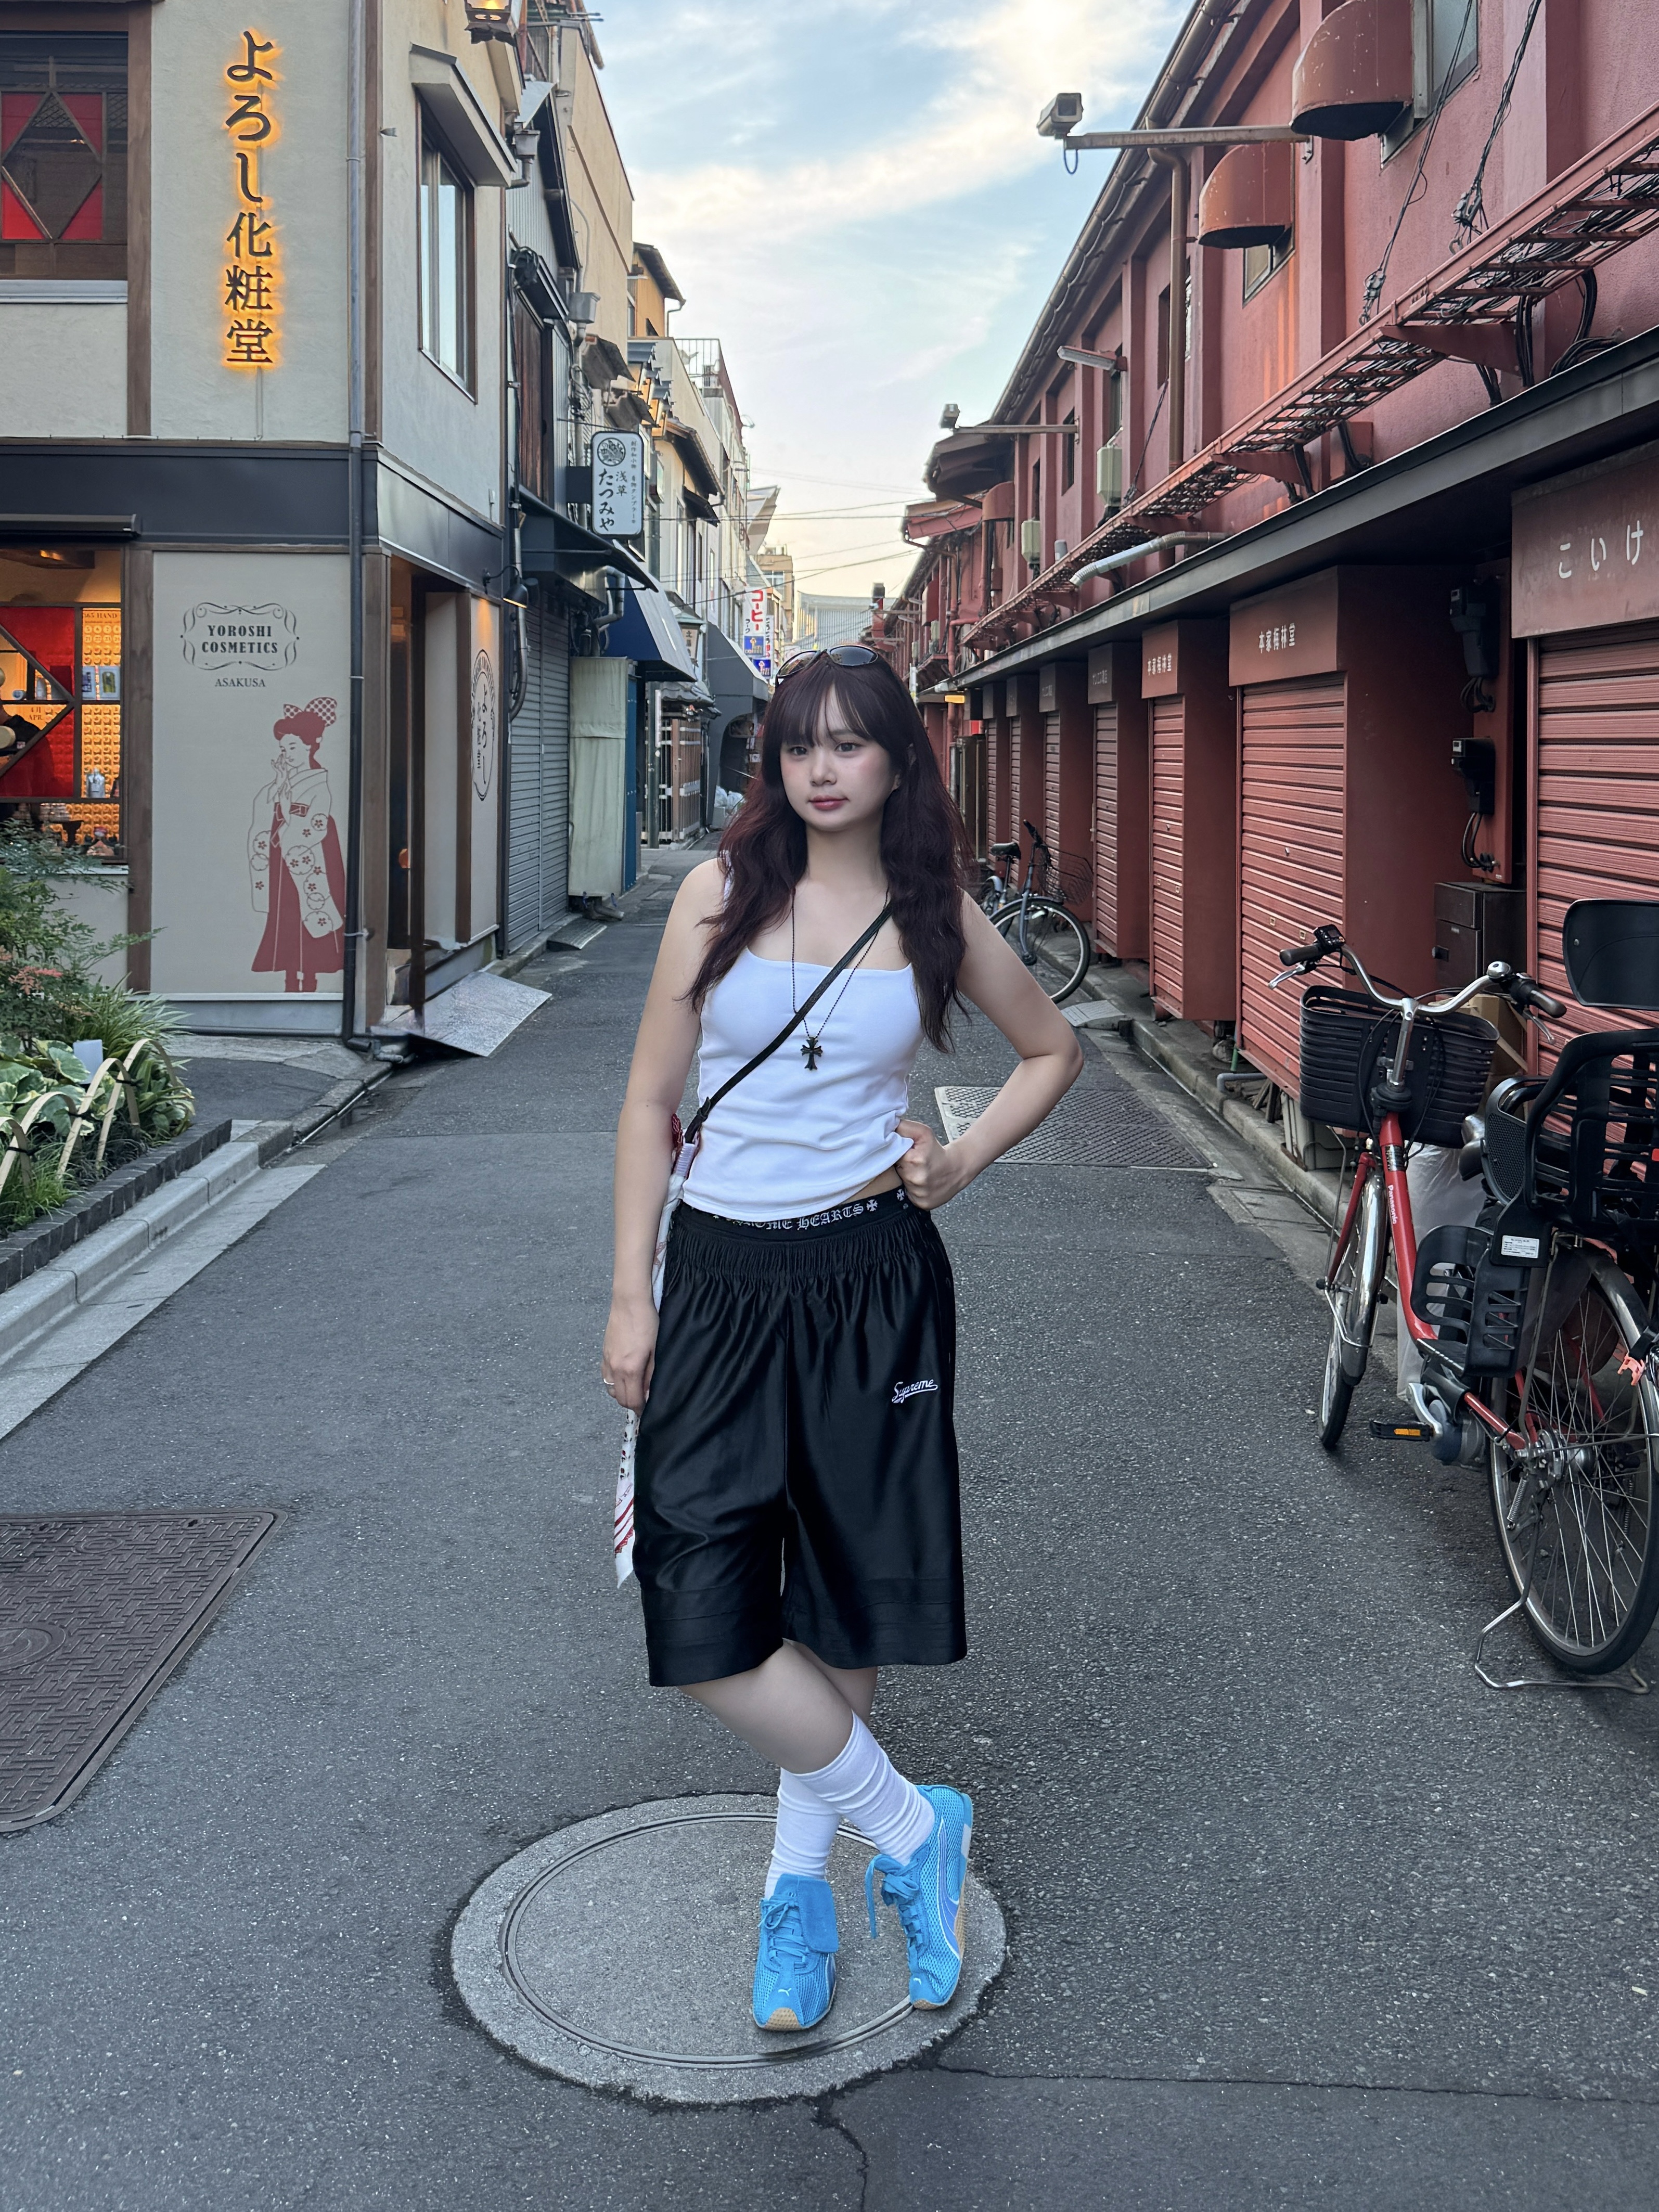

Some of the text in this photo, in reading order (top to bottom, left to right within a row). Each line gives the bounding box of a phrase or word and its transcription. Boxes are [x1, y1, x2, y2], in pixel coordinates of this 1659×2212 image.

[225, 31, 274, 364] よろし化粧堂
[615, 470, 627, 496] 浅草
[599, 468, 615, 531] たつみや
[1559, 520, 1643, 579] こいけ
[751, 589, 764, 631] コーヒー
[207, 625, 272, 637] YOROSHI
[201, 641, 278, 653] COSMETICS
[214, 678, 266, 687] ASAKUSA
[796, 1203, 864, 1231] HEARTS
[1387, 1185, 1398, 1224] Panasonic
[891, 1379, 938, 1404] Supreme
